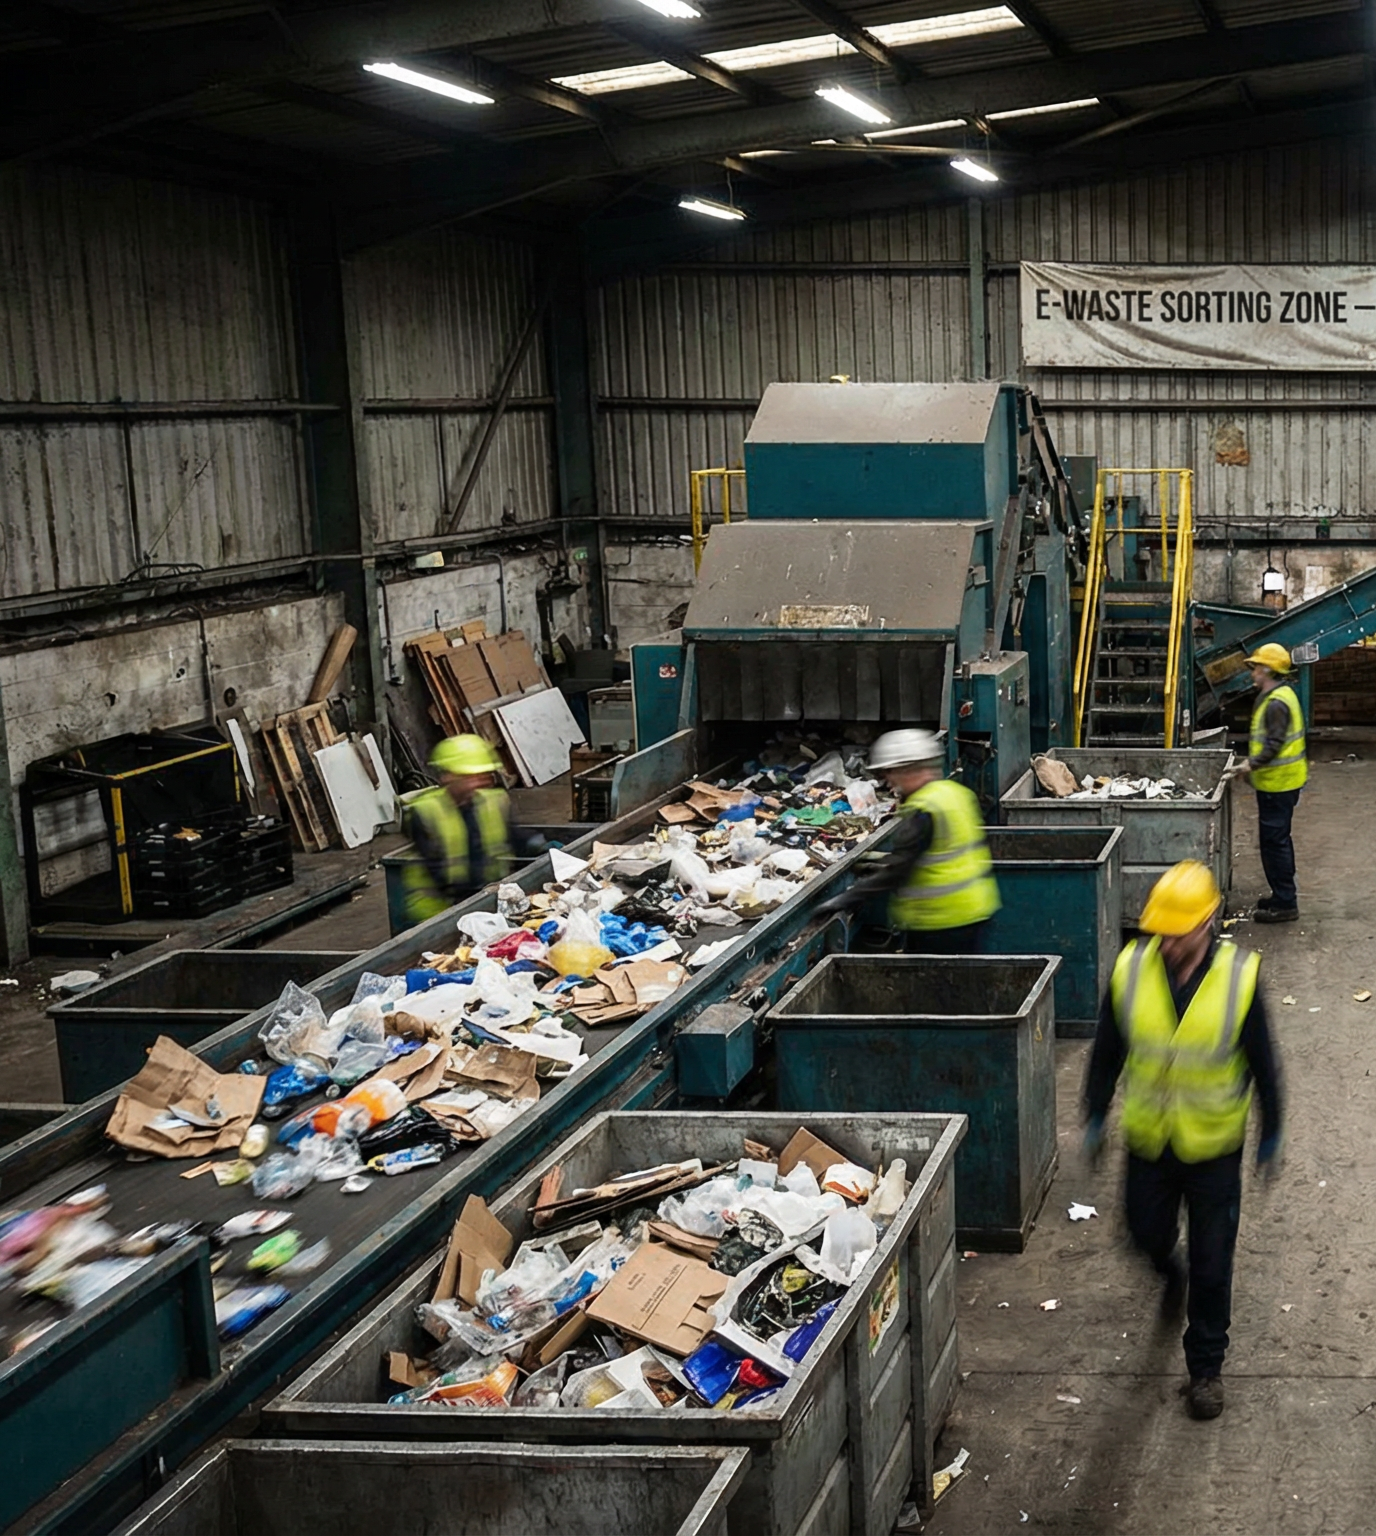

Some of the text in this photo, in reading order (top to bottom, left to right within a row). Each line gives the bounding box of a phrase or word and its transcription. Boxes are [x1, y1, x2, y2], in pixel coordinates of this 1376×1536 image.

[1036, 289, 1153, 322] E-WASTE
[1160, 291, 1272, 323] SORTING
[1279, 291, 1347, 323] ZONE
